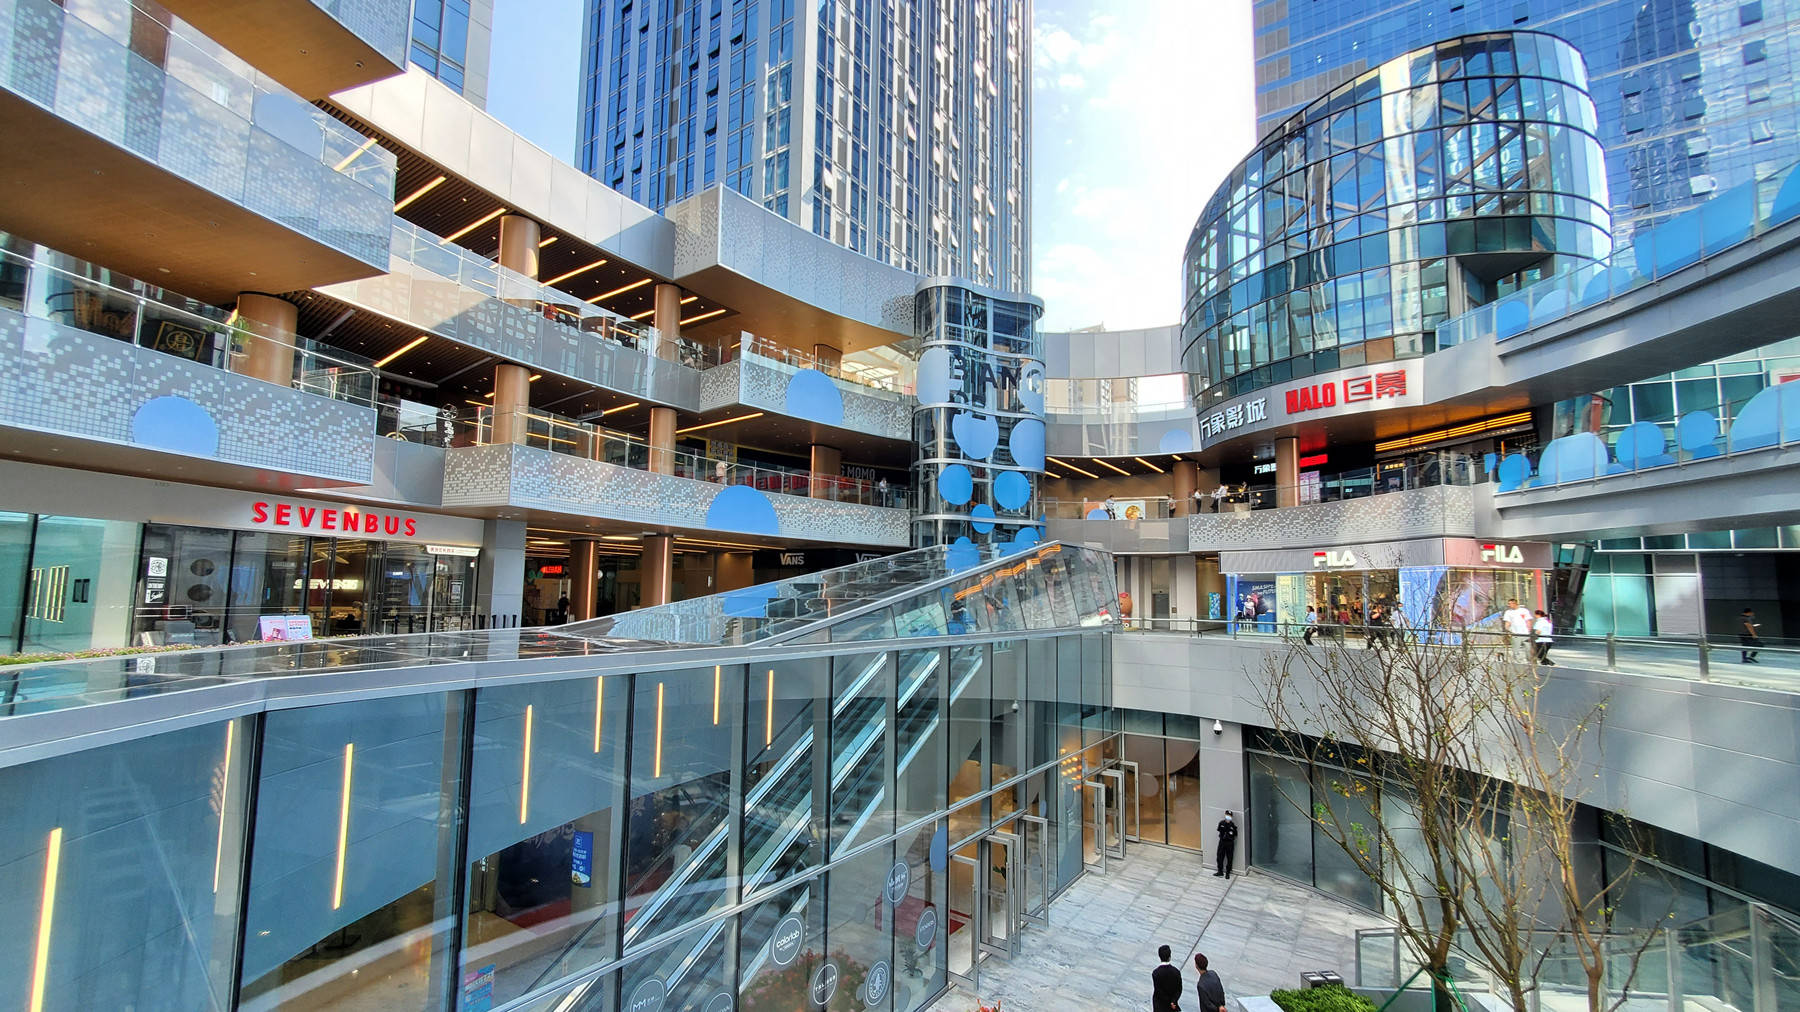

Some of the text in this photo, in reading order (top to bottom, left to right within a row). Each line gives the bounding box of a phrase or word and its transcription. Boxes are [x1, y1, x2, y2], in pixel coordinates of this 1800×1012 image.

[1285, 369, 1406, 414] HALO 巨幕
[1200, 397, 1267, 441] 万象影城
[252, 501, 417, 537] SEVENBUS
[779, 552, 805, 565] VANS
[1313, 551, 1357, 567] FILA
[1480, 543, 1525, 563] FILA
[776, 929, 800, 948] colorlab
